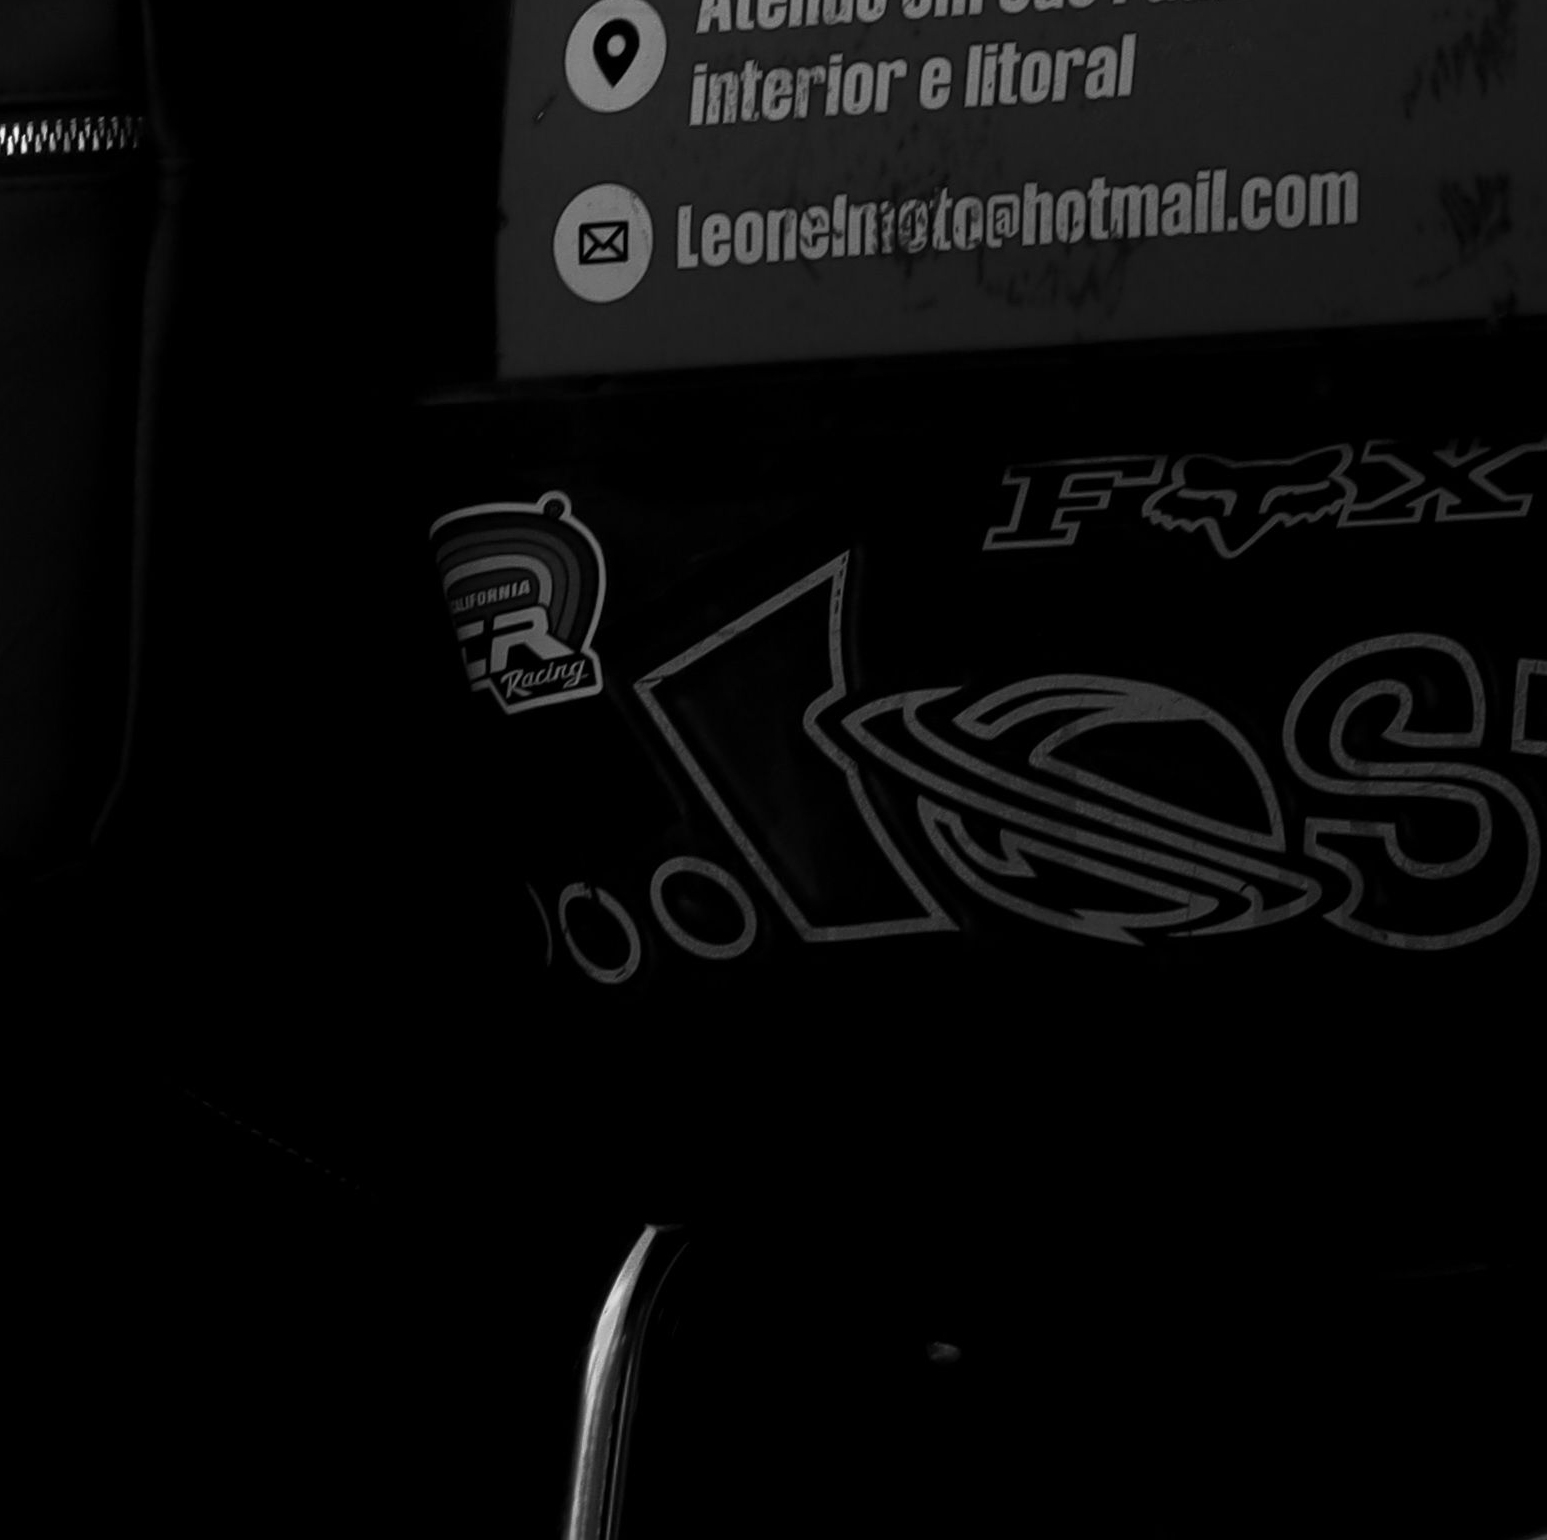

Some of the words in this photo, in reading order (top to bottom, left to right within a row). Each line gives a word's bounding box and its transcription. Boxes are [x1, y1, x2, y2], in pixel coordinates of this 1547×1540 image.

[688, 51, 908, 127] interior
[918, 54, 954, 111] e
[963, 32, 1138, 109] litoral
[500, 657, 590, 700] Racing
